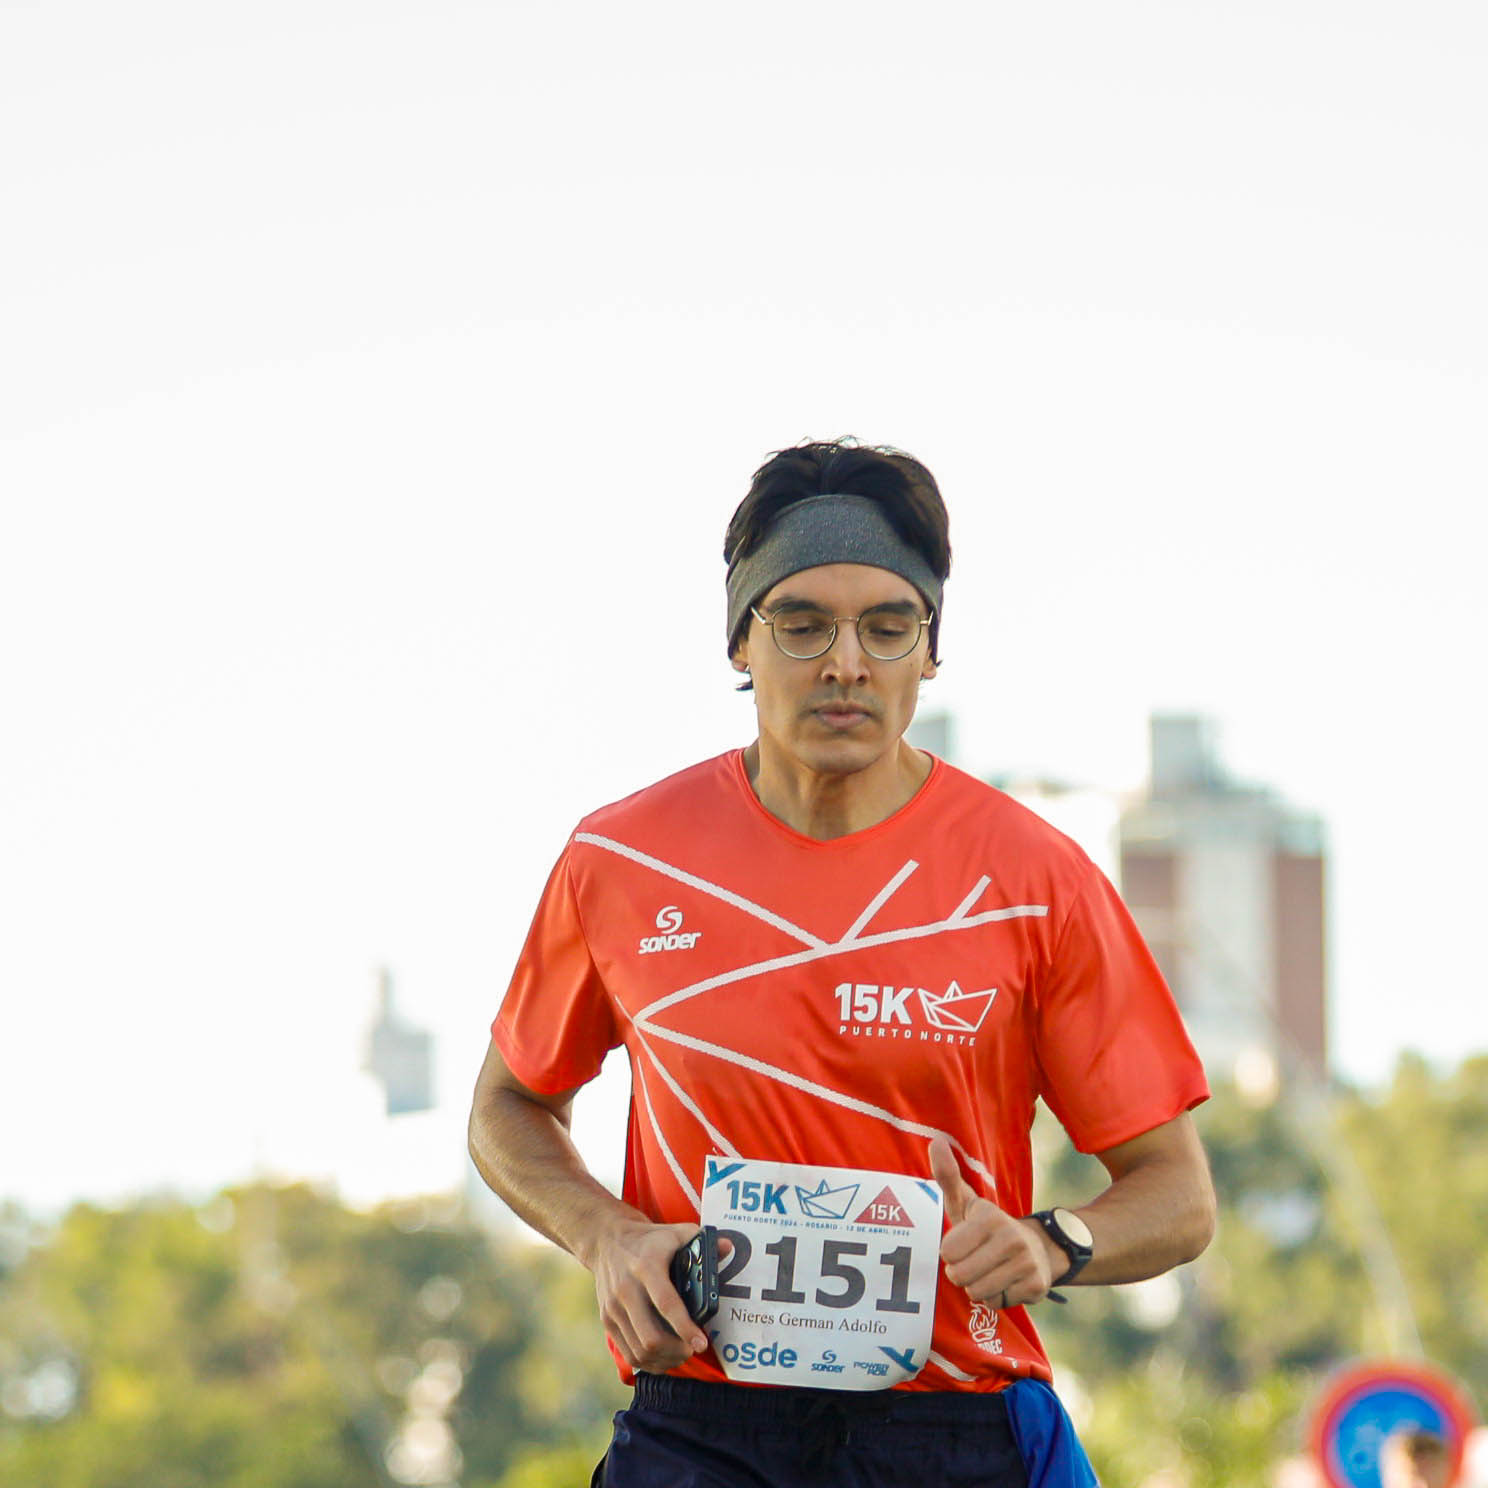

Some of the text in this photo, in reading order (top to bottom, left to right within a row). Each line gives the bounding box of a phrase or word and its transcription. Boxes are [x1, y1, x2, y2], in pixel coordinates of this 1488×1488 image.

[835, 983, 914, 1025] 15K
[839, 1026, 976, 1047] PUERTO NORTE
[727, 1180, 789, 1215] 15K
[724, 1213, 752, 1223] PUERTO
[754, 1216, 777, 1225] NORTE
[805, 1221, 838, 1230] ROSARIO
[869, 1227, 889, 1235] ABRIL
[869, 1203, 902, 1222] 15K
[715, 1229, 920, 1314] 2151
[730, 1307, 888, 1335] Nieres German Adolfo
[722, 1341, 798, 1369] osde
